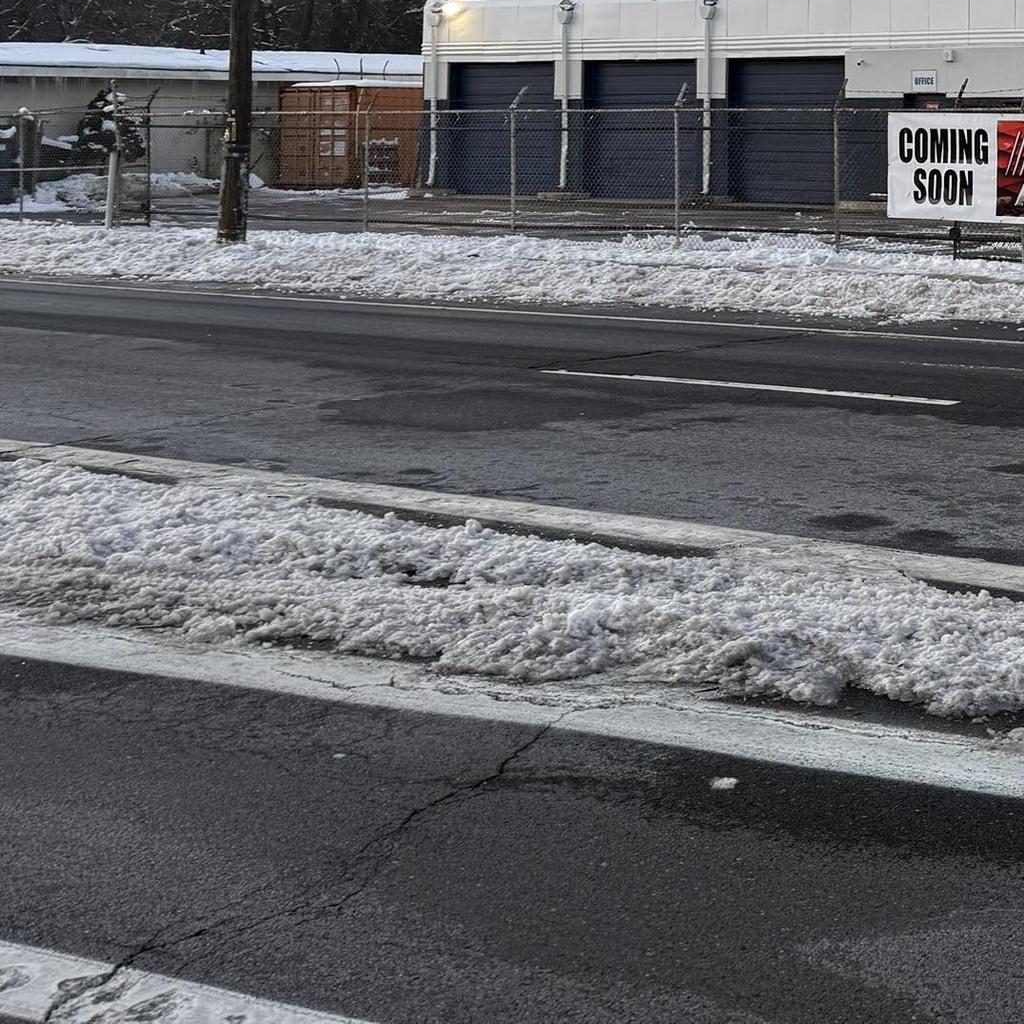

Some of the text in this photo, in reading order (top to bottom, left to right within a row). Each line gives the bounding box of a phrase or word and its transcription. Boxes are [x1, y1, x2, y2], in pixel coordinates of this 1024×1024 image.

[914, 77, 934, 85] OFFICE
[899, 127, 989, 165] COMING
[913, 168, 973, 206] SOON
